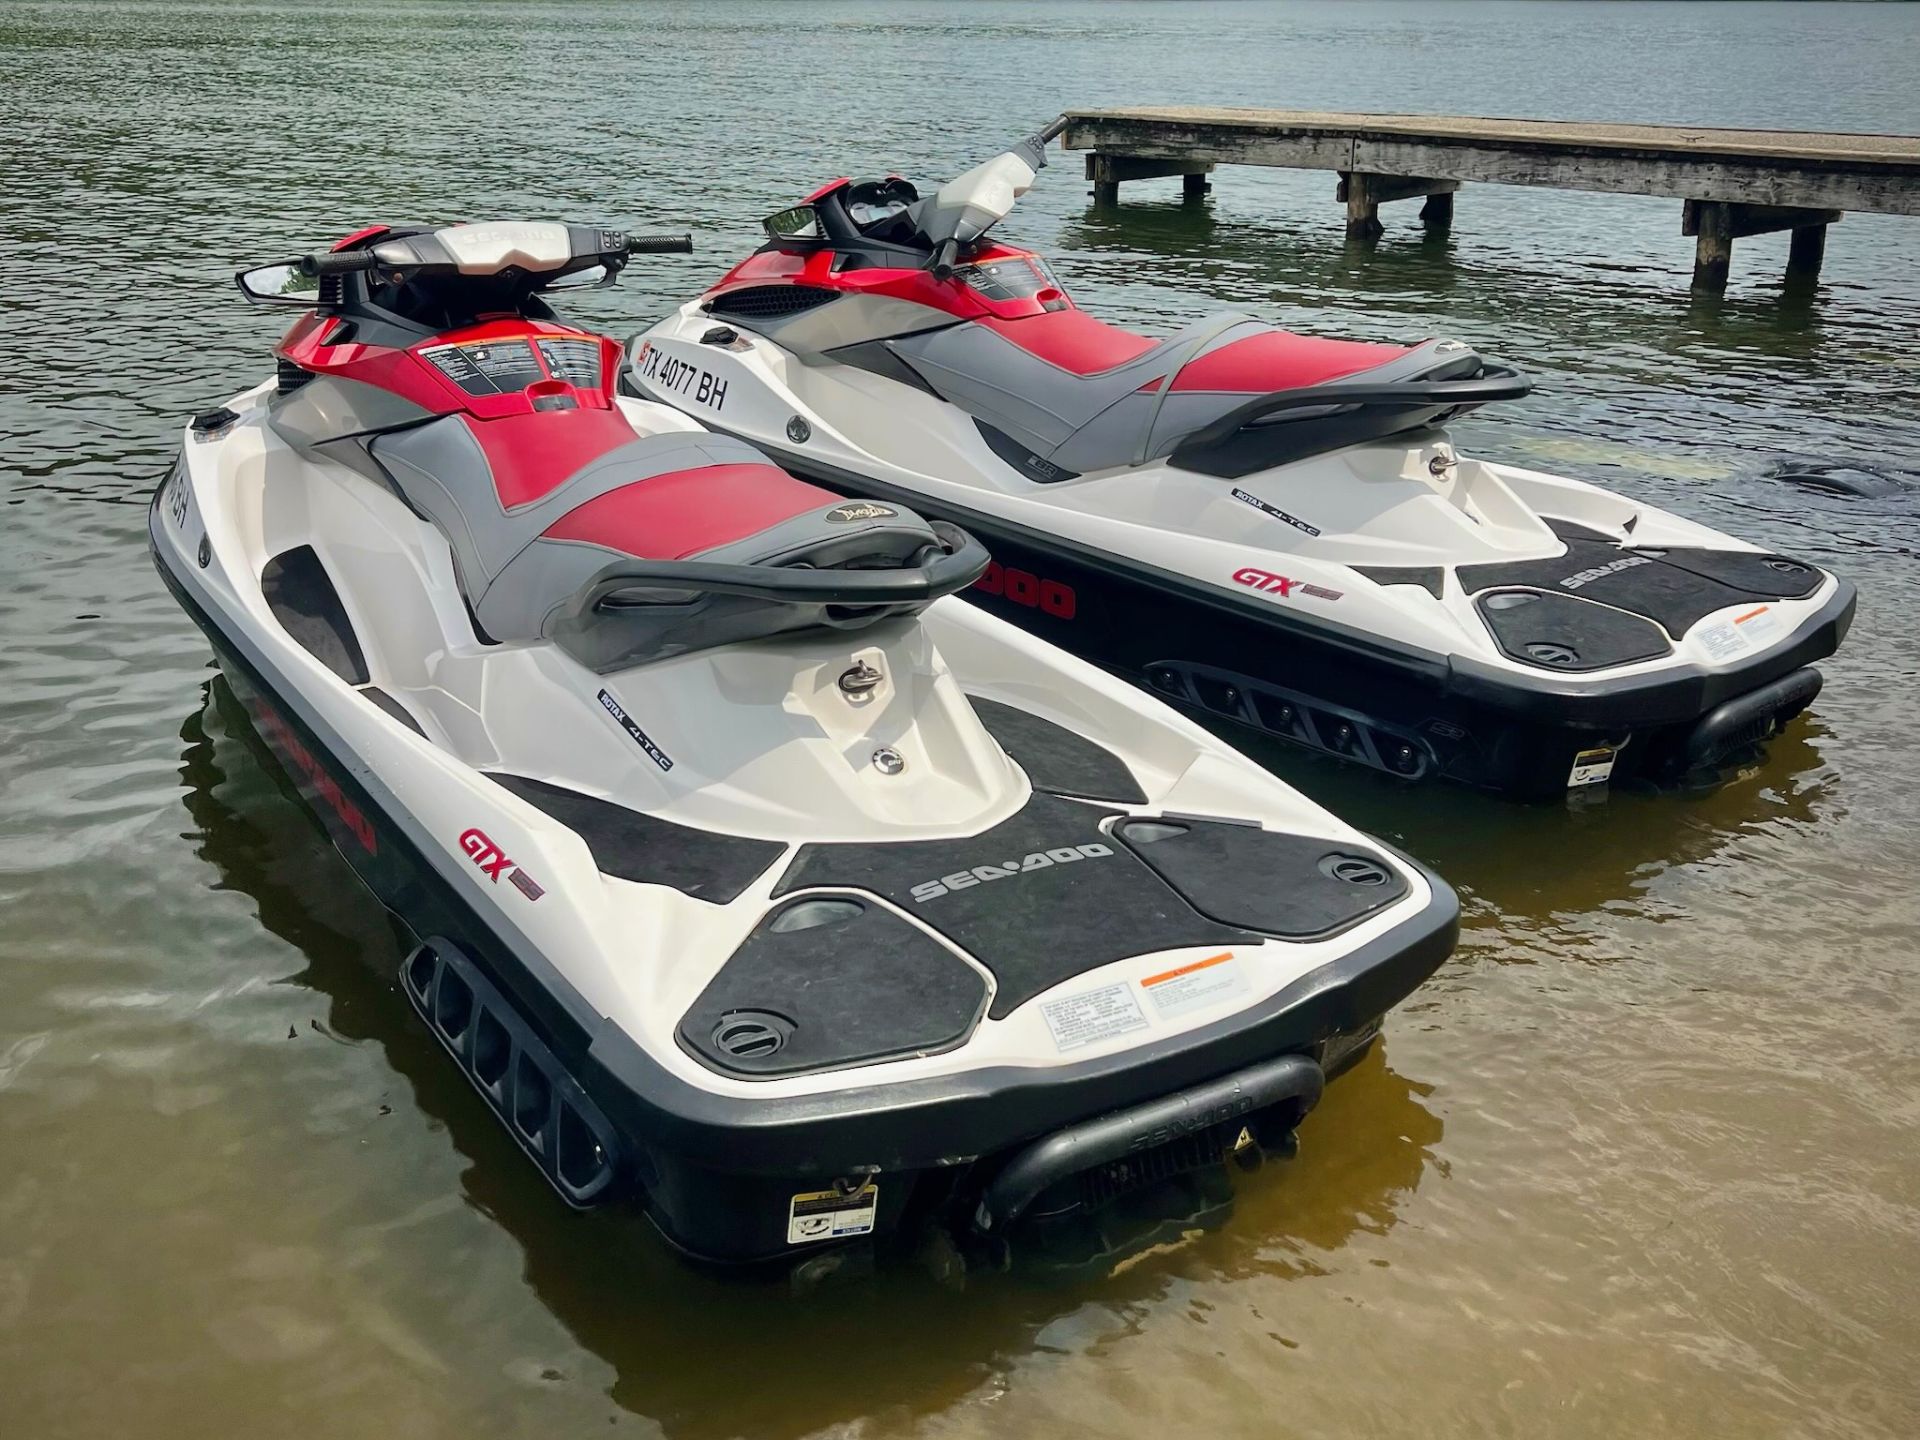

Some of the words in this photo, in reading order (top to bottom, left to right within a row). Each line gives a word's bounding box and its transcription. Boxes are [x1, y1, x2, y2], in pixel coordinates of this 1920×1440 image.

[643, 348, 662, 379] TX
[659, 356, 697, 394] 4077
[696, 371, 728, 411] BH
[1236, 491, 1264, 509] ROTAX
[1232, 568, 1303, 598] GTX
[601, 693, 626, 722] ROTAX
[629, 726, 671, 769] 4-TEC
[459, 828, 518, 884] GTX
